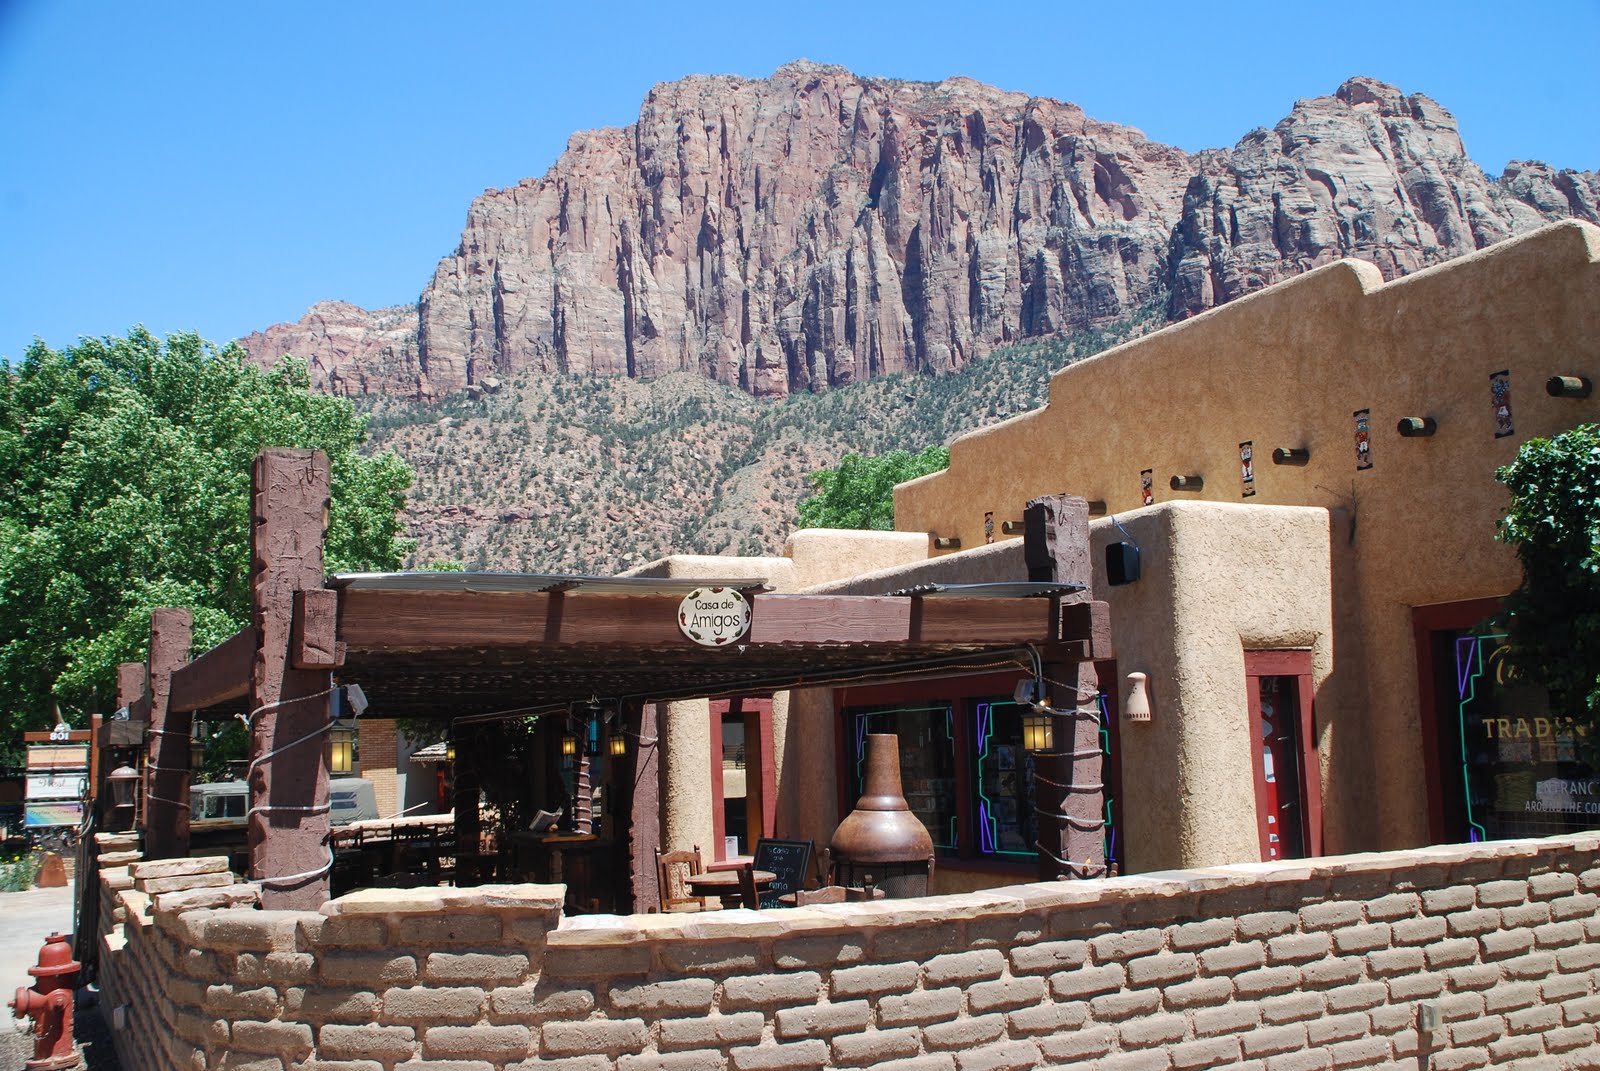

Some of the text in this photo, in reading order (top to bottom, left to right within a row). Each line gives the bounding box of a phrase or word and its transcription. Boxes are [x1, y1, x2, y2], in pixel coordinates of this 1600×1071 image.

[695, 599, 734, 610] Casa de
[691, 613, 740, 636] Amigos
[1536, 781, 1600, 795] ENTRANC
